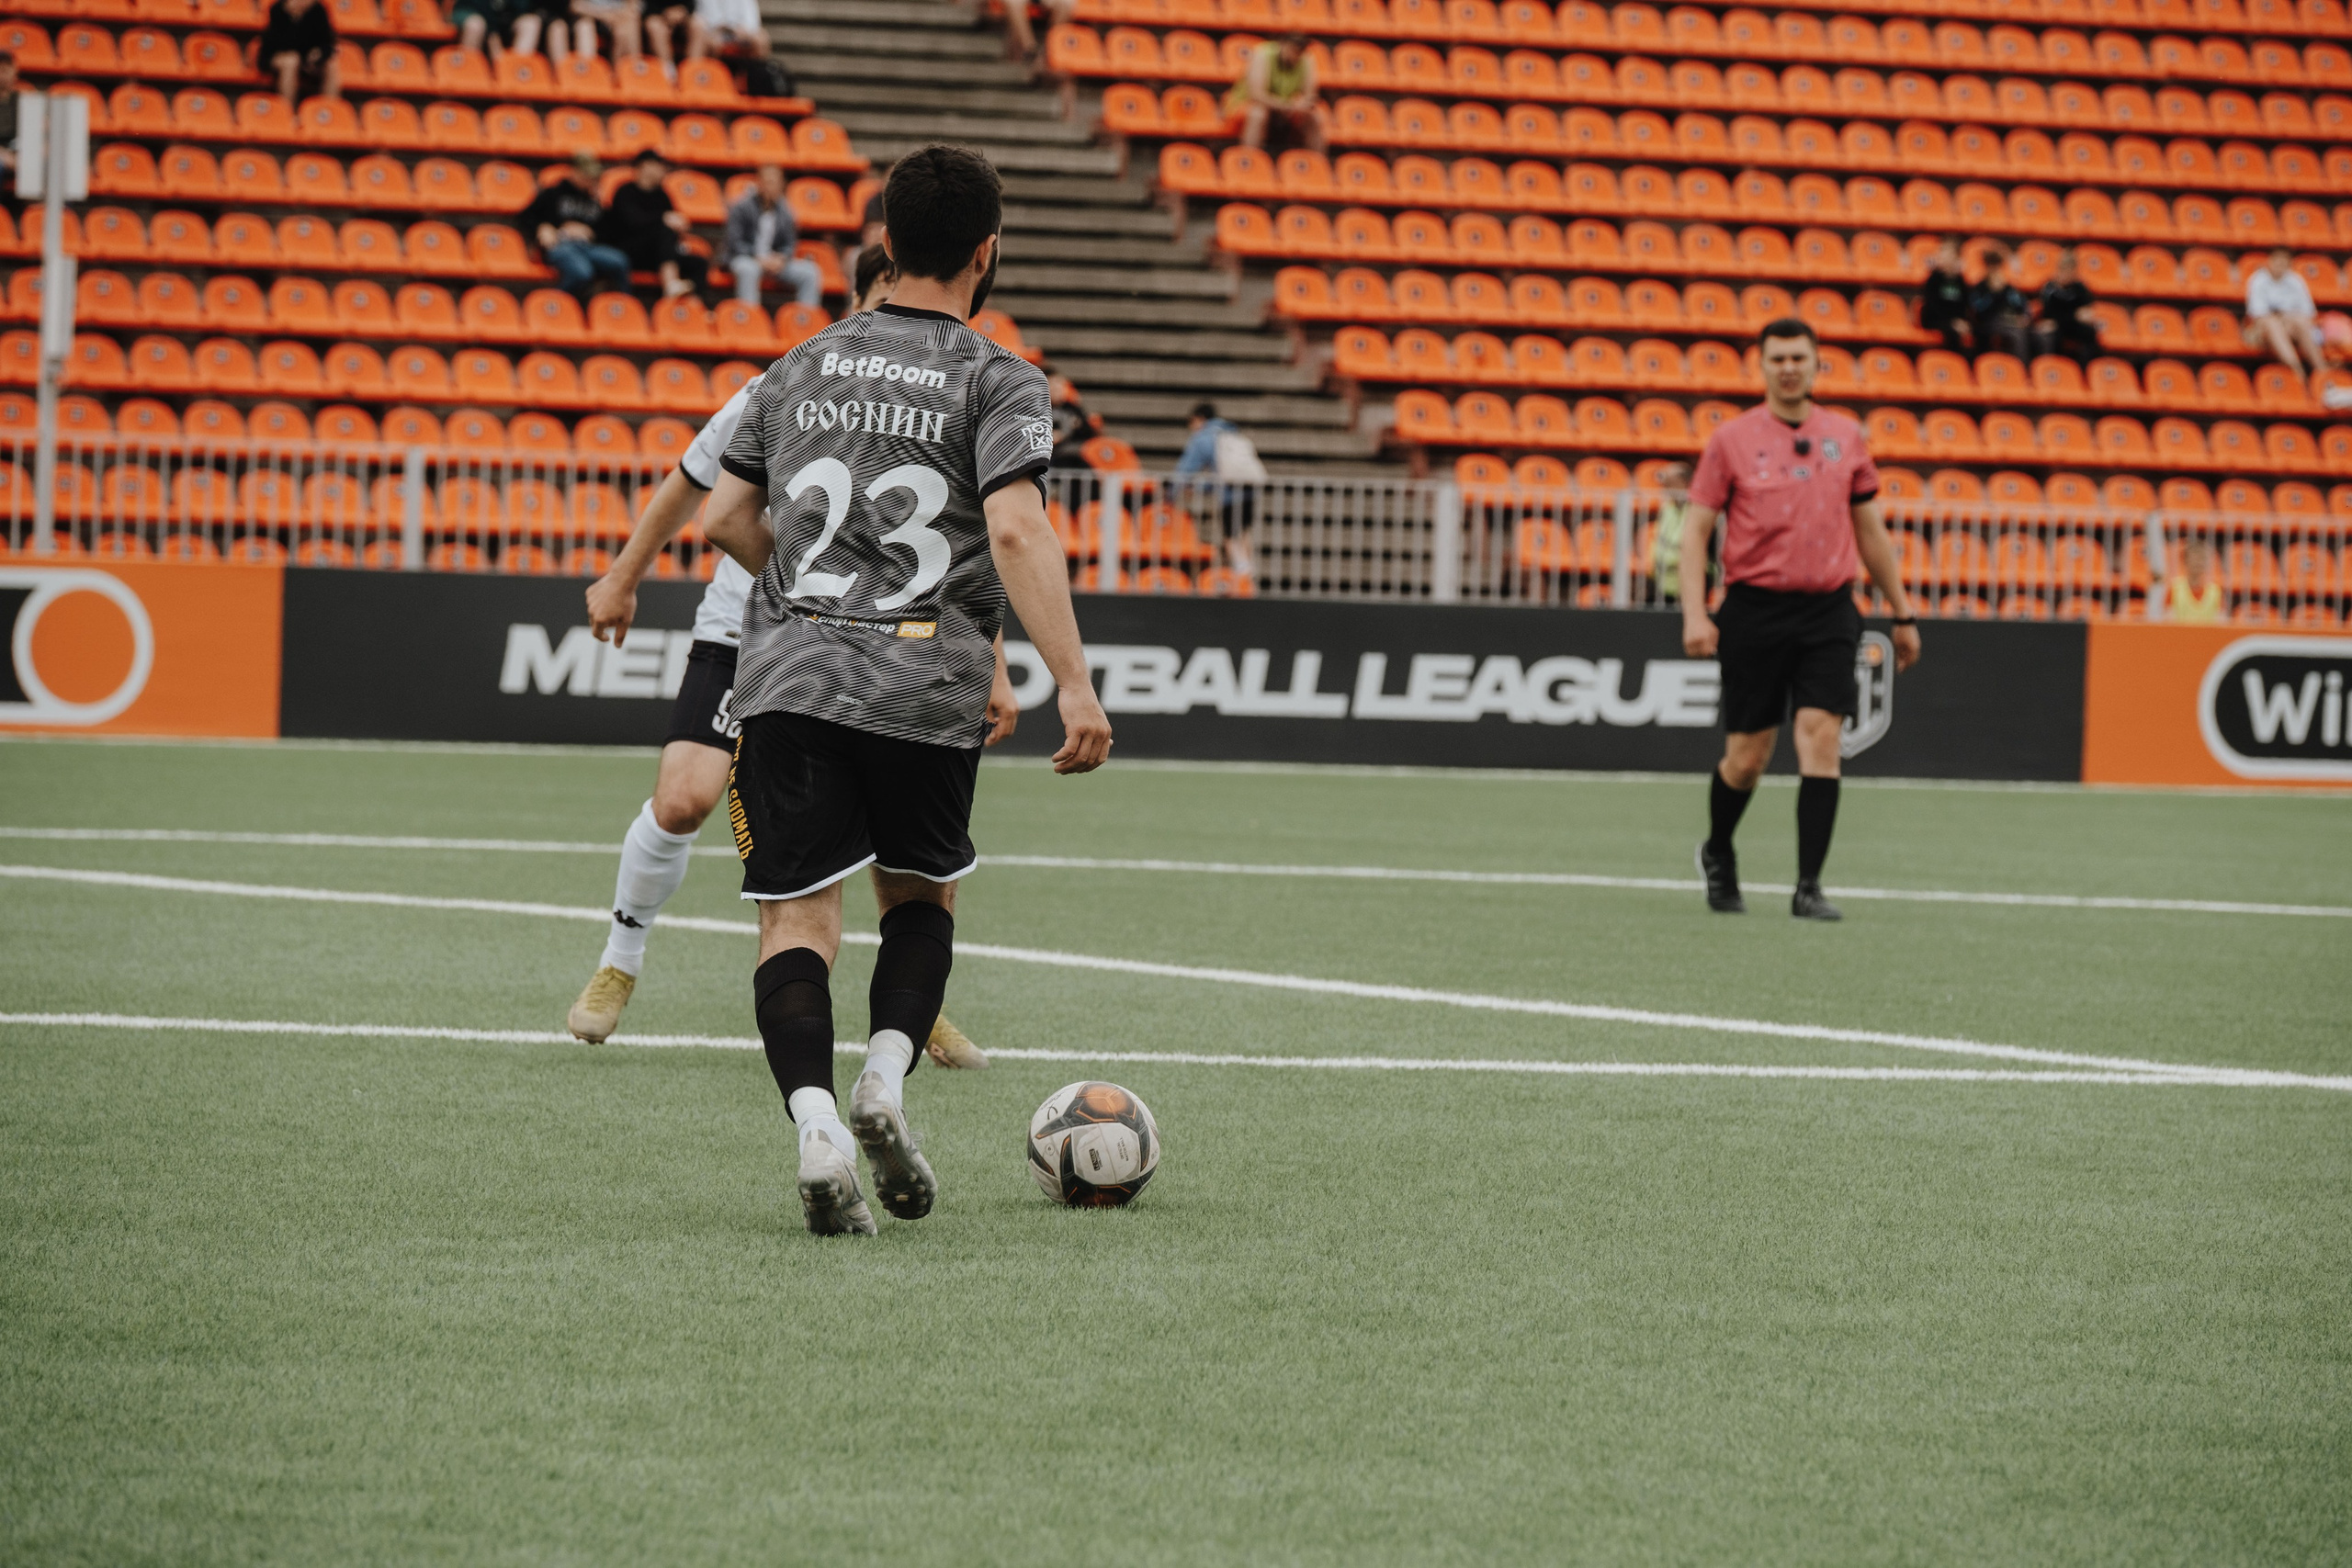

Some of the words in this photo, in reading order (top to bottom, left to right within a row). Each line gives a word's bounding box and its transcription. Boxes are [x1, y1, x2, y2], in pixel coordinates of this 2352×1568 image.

[821, 353, 946, 389] BetBoom
[785, 457, 952, 611] 23
[900, 624, 933, 637] PRO
[1351, 651, 1723, 728] LEAGUE
[2242, 668, 2352, 748] Wi
